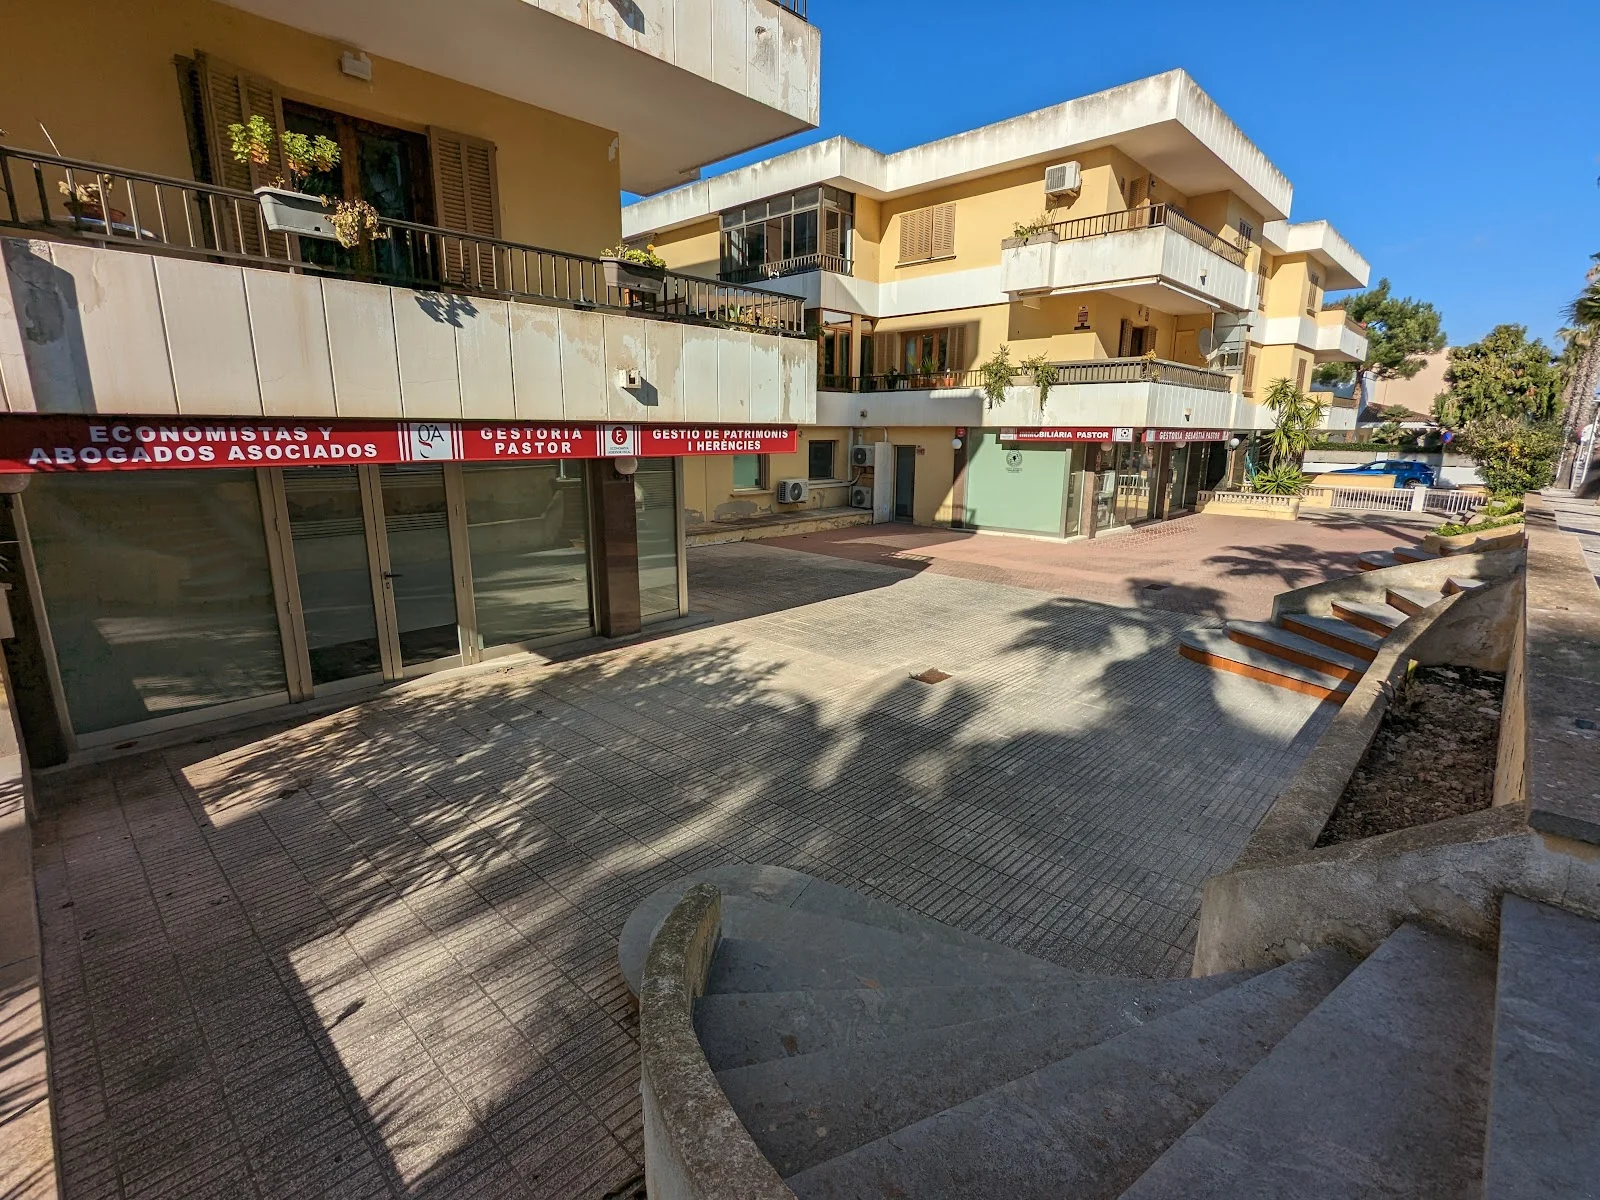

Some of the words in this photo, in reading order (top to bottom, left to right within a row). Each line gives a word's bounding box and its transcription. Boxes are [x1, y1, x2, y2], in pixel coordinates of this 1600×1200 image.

[89, 425, 308, 443] ECONOMISTAS
[318, 426, 333, 441] Y
[480, 427, 583, 440] GESTORIA
[652, 427, 700, 440] GESTIÓ
[704, 429, 720, 440] DE
[723, 428, 789, 439] PATRIMONIS
[1019, 429, 1073, 439] IMMOBILIÀRIA
[1076, 431, 1109, 439] PASTOR
[494, 441, 572, 455] PASTOR
[687, 441, 692, 452] I
[697, 438, 761, 451] HERÈNCIES
[28, 445, 216, 465] ABOGADOS
[227, 443, 378, 461] ASOCIADOS
